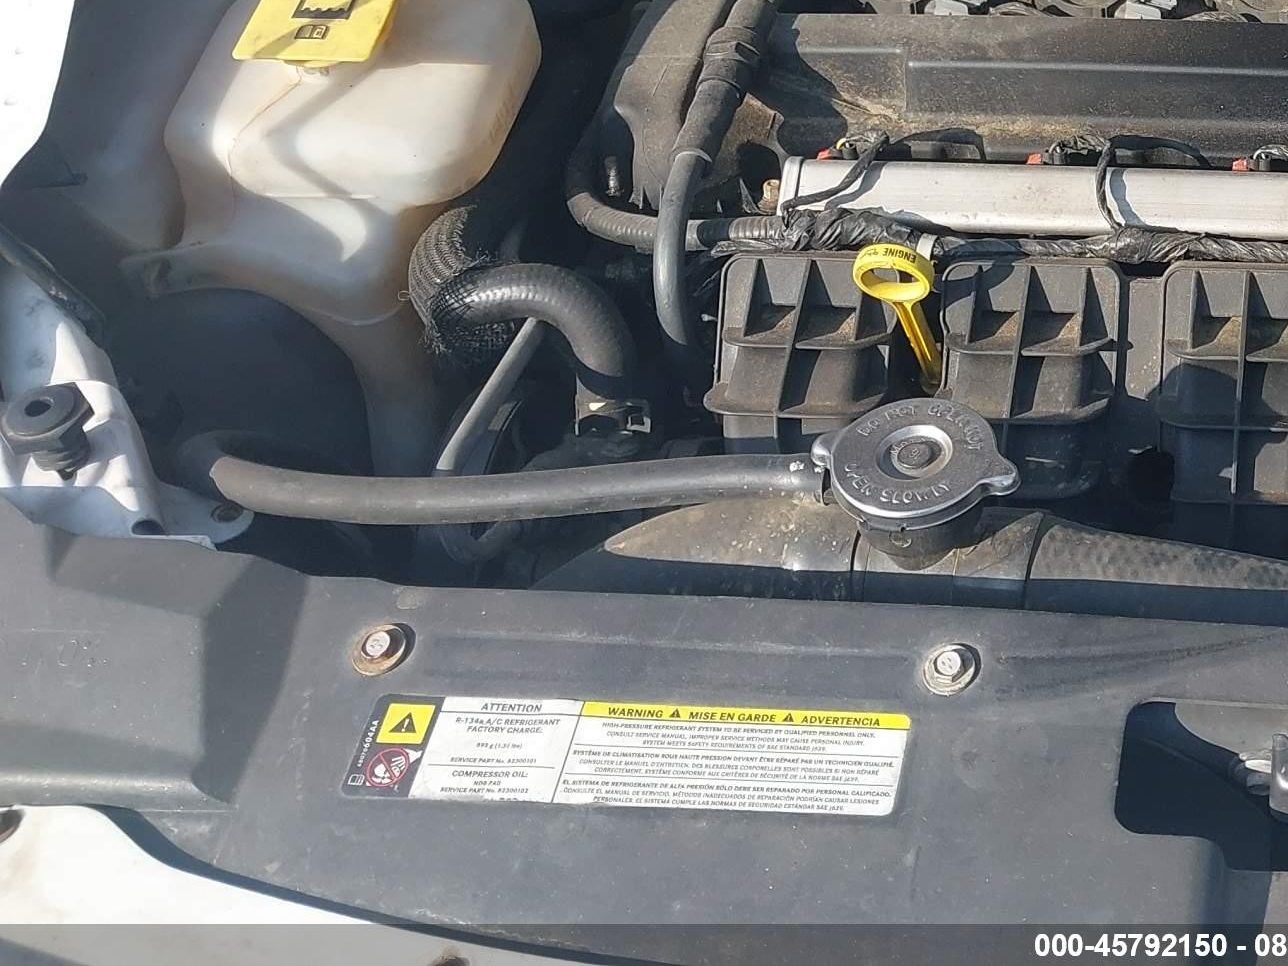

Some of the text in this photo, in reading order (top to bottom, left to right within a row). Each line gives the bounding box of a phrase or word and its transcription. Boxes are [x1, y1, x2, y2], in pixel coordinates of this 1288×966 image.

[882, 247, 917, 264] ENGINE
[879, 483, 951, 504] SLOWLY
[480, 702, 542, 713] ATTENTION
[455, 716, 561, 726] R-134a A/C REFRIGERANT
[608, 706, 881, 727] WARNING MISE EN GARDE ADVERTENCIA
[466, 726, 544, 734] FACTORY CHARGE:
[654, 723, 696, 732] REFRIGERANT
[697, 725, 722, 733] SYSTEM
[606, 730, 634, 738] CONSULT
[642, 739, 666, 747] SYSTEM
[700, 754, 732, 762] PRESSION
[733, 755, 757, 763] DEVANT
[451, 769, 529, 778] COMPRESSOR OIL:
[572, 779, 600, 787] SISTEMA
[815, 788, 849, 796] PERSONAL
[604, 789, 630, 797] MANUAL
[644, 797, 670, 805] SISTEMA
[671, 798, 697, 806] CUMPLE
[710, 800, 737, 808] NORMAS
